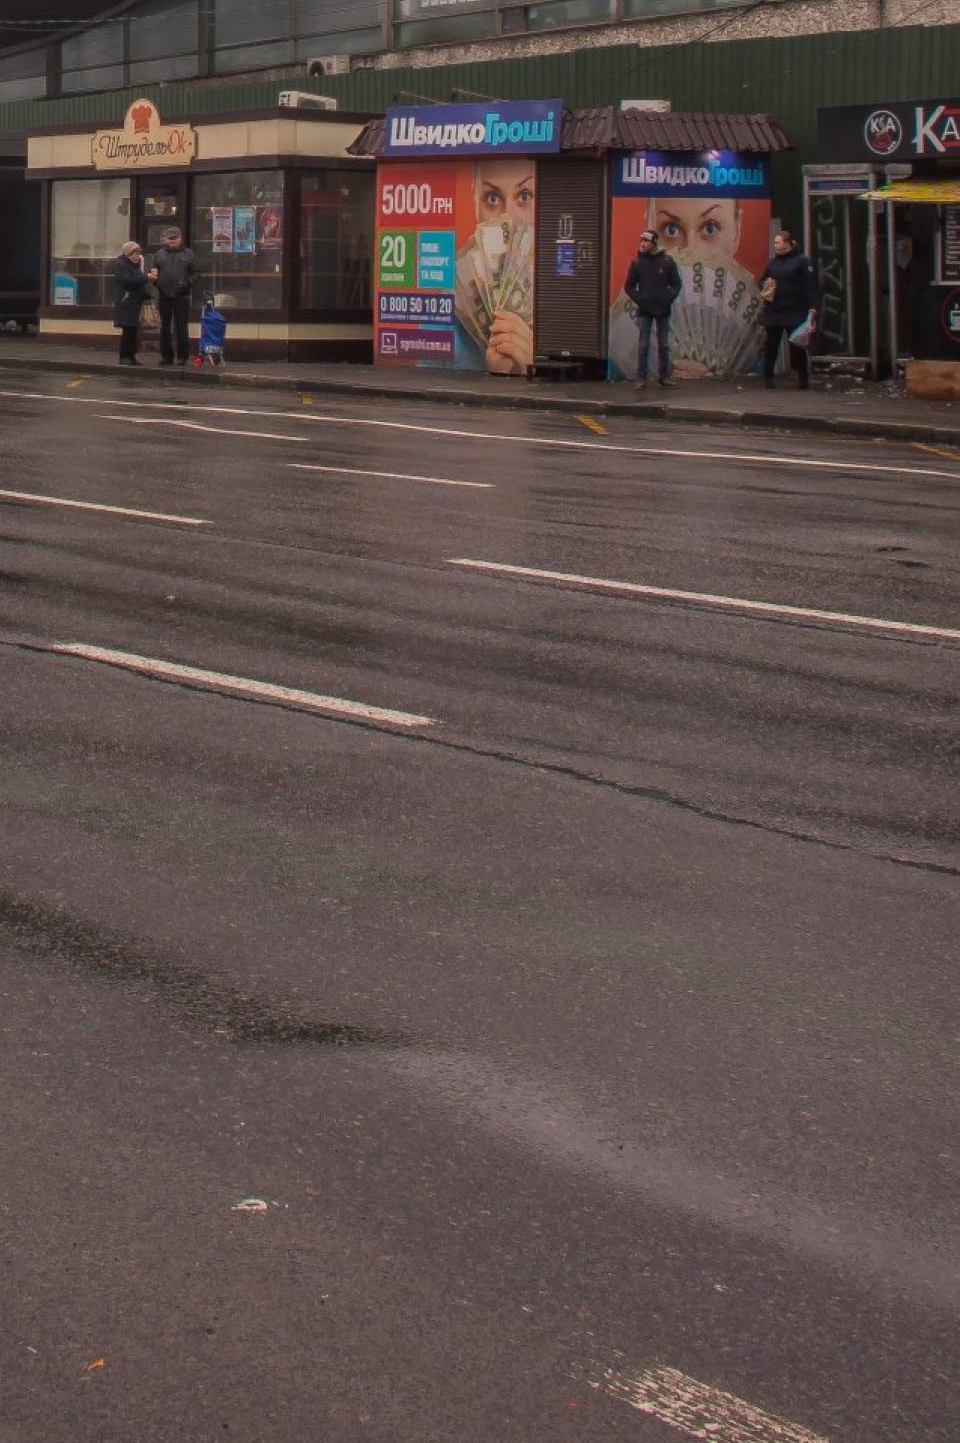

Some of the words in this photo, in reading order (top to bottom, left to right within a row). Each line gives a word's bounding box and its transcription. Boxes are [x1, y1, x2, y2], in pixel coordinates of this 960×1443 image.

[390, 111, 555, 147] ШвидкоГроші
[622, 156, 763, 186] ШвидкоГроші
[382, 183, 431, 215] 5000
[432, 197, 453, 214] ГРН
[381, 235, 406, 268] 20
[693, 262, 703, 293] 500
[713, 267, 725, 299] 500
[381, 297, 387, 312] 0
[390, 297, 407, 312] 800
[410, 297, 422, 313] 50
[424, 298, 437, 313] 10
[439, 298, 452, 314] 20
[728, 280, 746, 312] 500
[743, 297, 759, 323] 500
